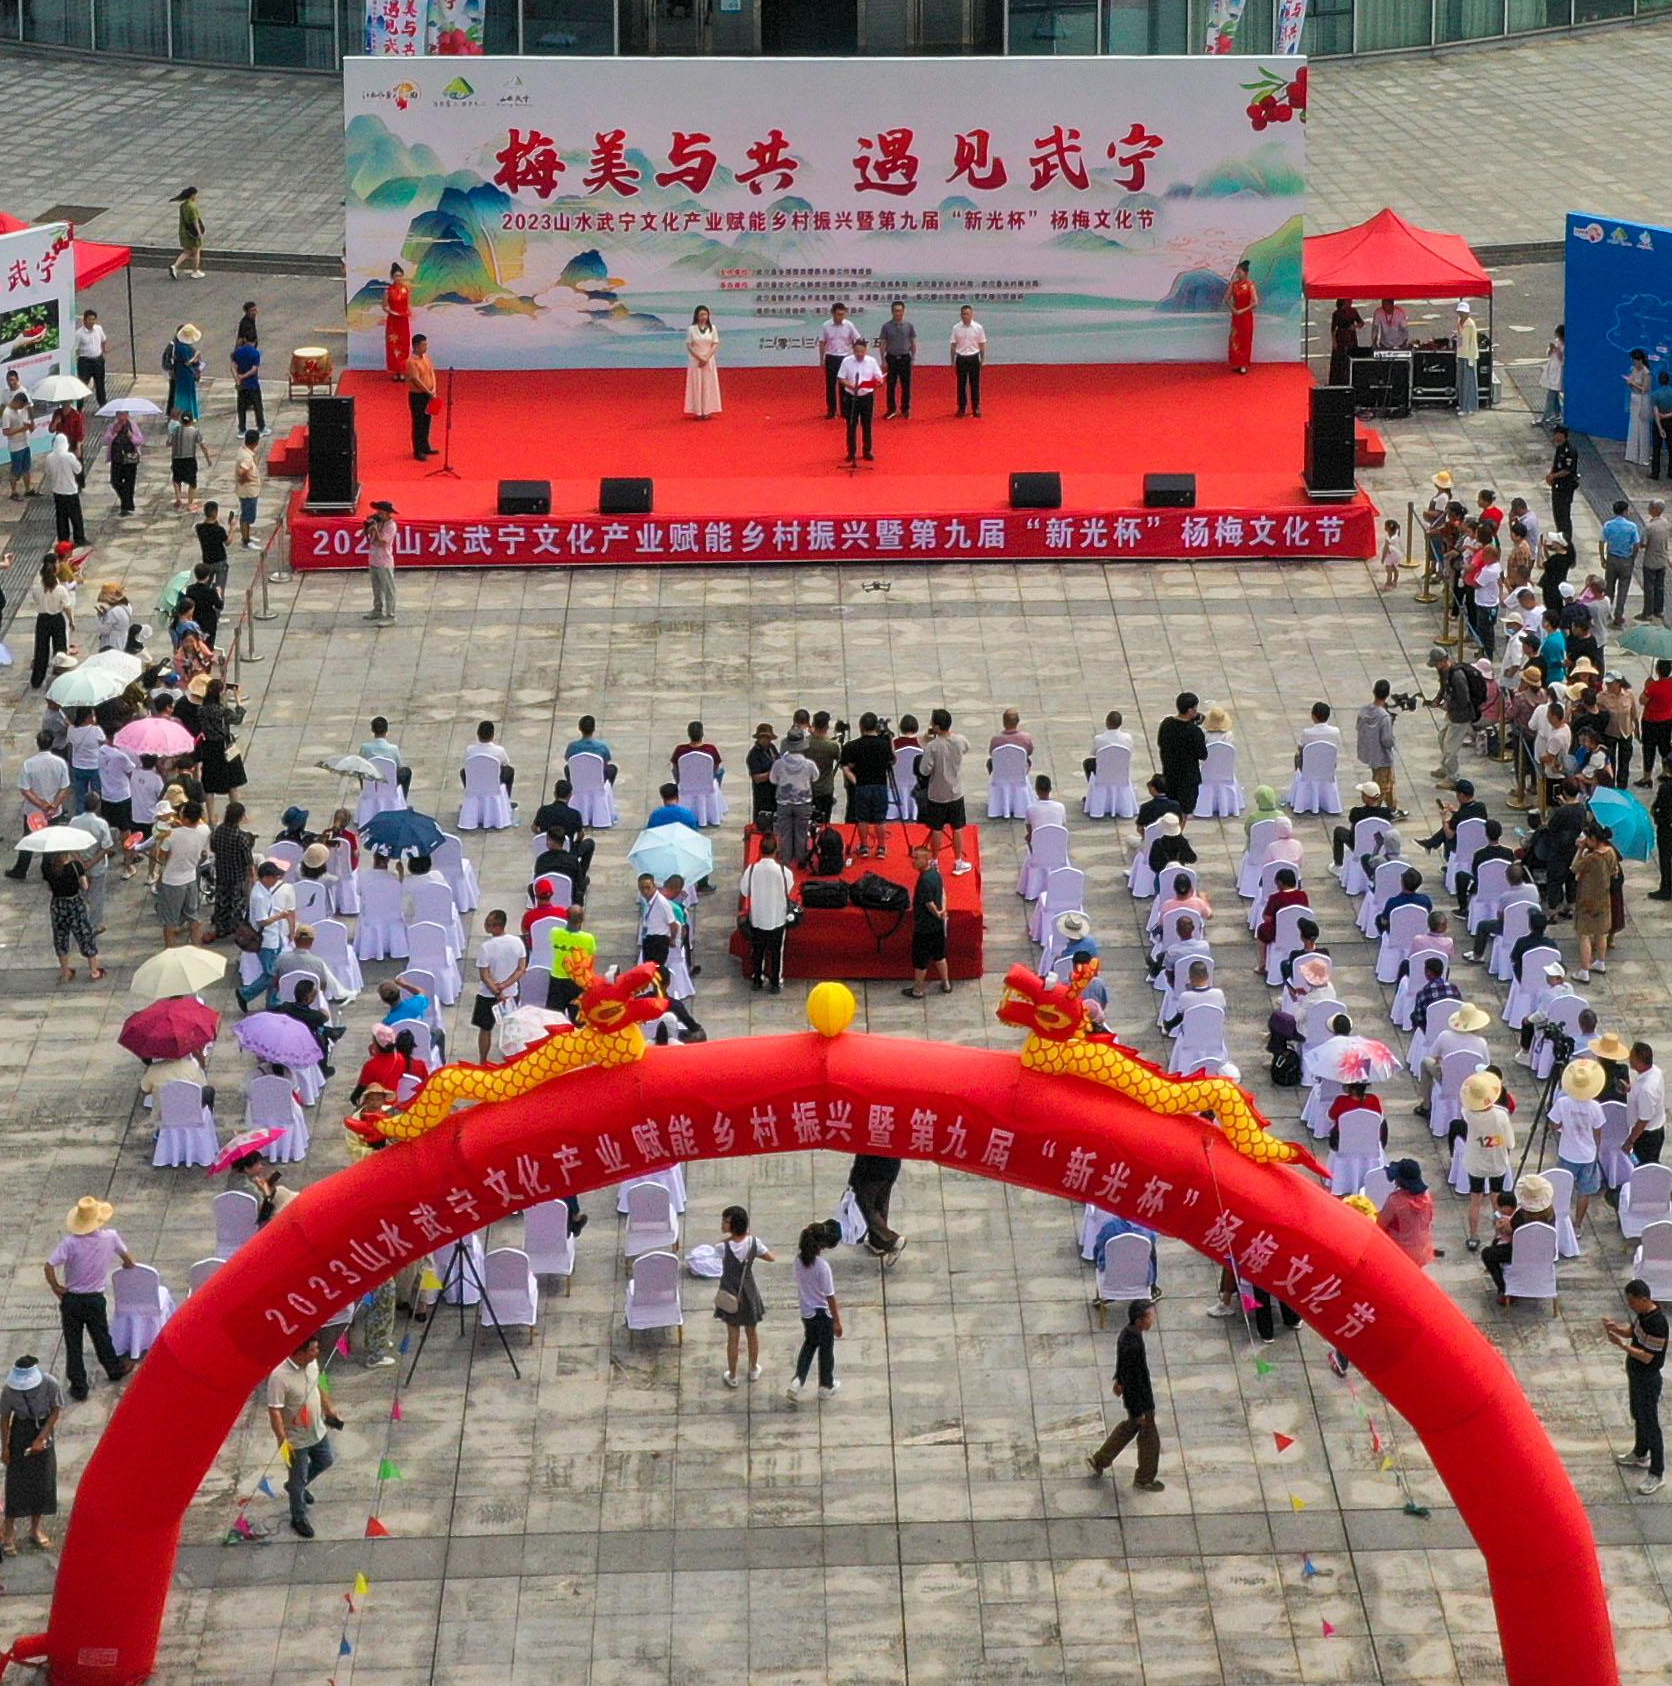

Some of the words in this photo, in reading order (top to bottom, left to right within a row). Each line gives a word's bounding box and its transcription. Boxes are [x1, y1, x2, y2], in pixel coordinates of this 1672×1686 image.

[494, 128, 801, 199] 梅美与共
[853, 124, 1166, 196] 遇见武宁
[313, 516, 1345, 557] 202山水武宁文化产业赋能乡村振兴暨第九届“新光杯”杨梅文化节
[1477, 1134, 1504, 1148] 123
[264, 1099, 1378, 1338] 2023山水武宁文化产业赋能乡村振兴暨第九届“新光杯”杨梅文化节
